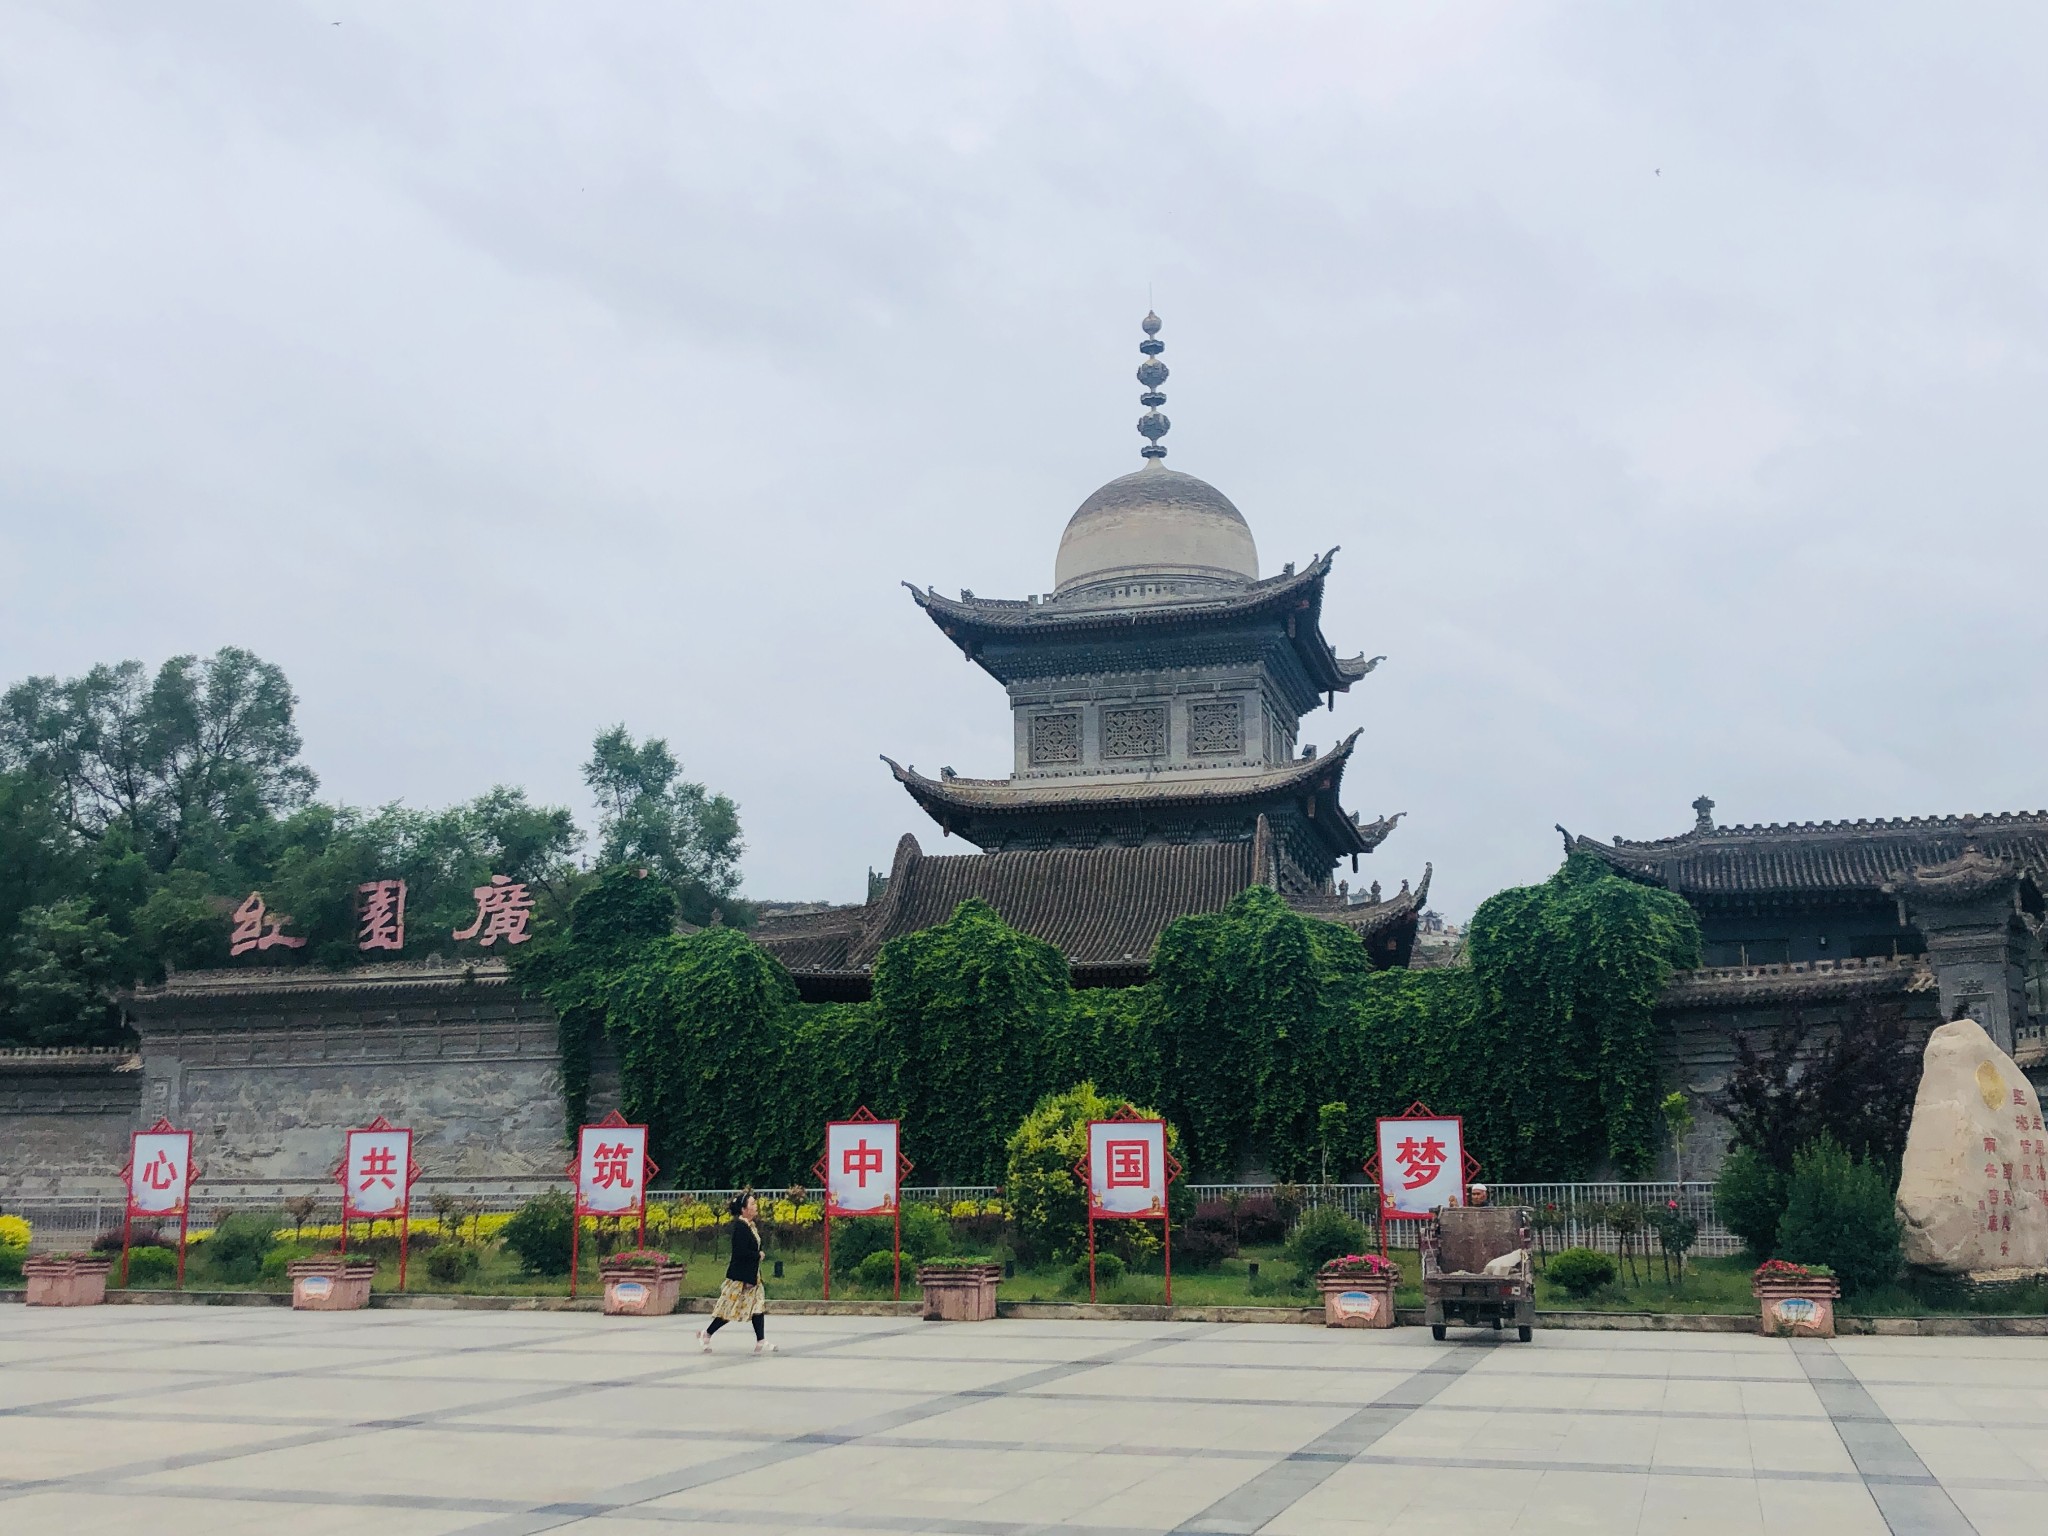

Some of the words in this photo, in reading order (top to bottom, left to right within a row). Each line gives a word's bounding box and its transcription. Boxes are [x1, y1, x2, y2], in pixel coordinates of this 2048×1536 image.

[142, 1149, 178, 1190] 心
[360, 1147, 396, 1191] 共
[592, 1142, 634, 1190] 筑
[843, 1139, 883, 1188] 中
[1106, 1140, 1150, 1189] 国
[1395, 1136, 1447, 1190] 梦
